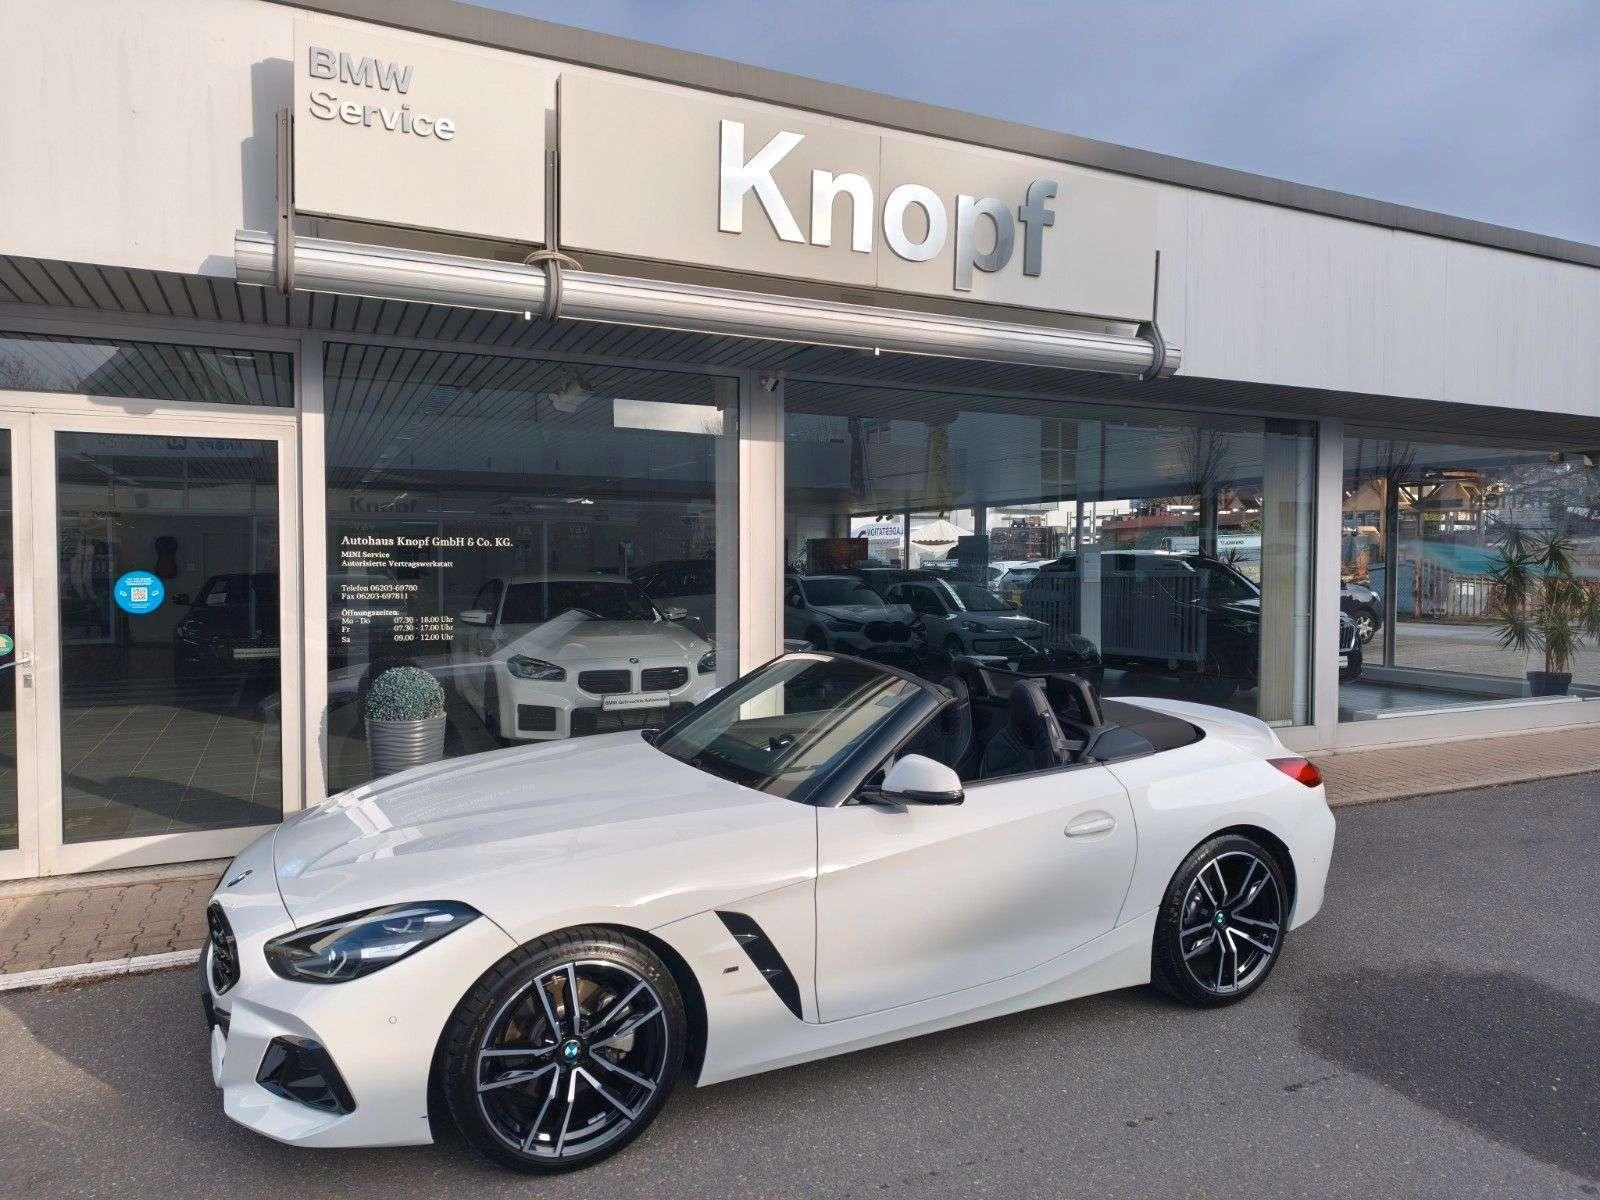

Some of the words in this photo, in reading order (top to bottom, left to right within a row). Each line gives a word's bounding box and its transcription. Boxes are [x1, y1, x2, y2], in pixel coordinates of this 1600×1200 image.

[309, 46, 415, 94] BMW
[309, 90, 456, 140] Service
[718, 119, 1058, 291] Knopf
[341, 536, 394, 546] Autohaus
[397, 536, 429, 548] Knopf
[432, 537, 464, 547] GmbH
[467, 537, 474, 547] &
[476, 537, 492, 547] Co.
[495, 537, 513, 547] KG.
[362, 550, 390, 558] Service
[388, 560, 453, 568] Vertragswerkstatt
